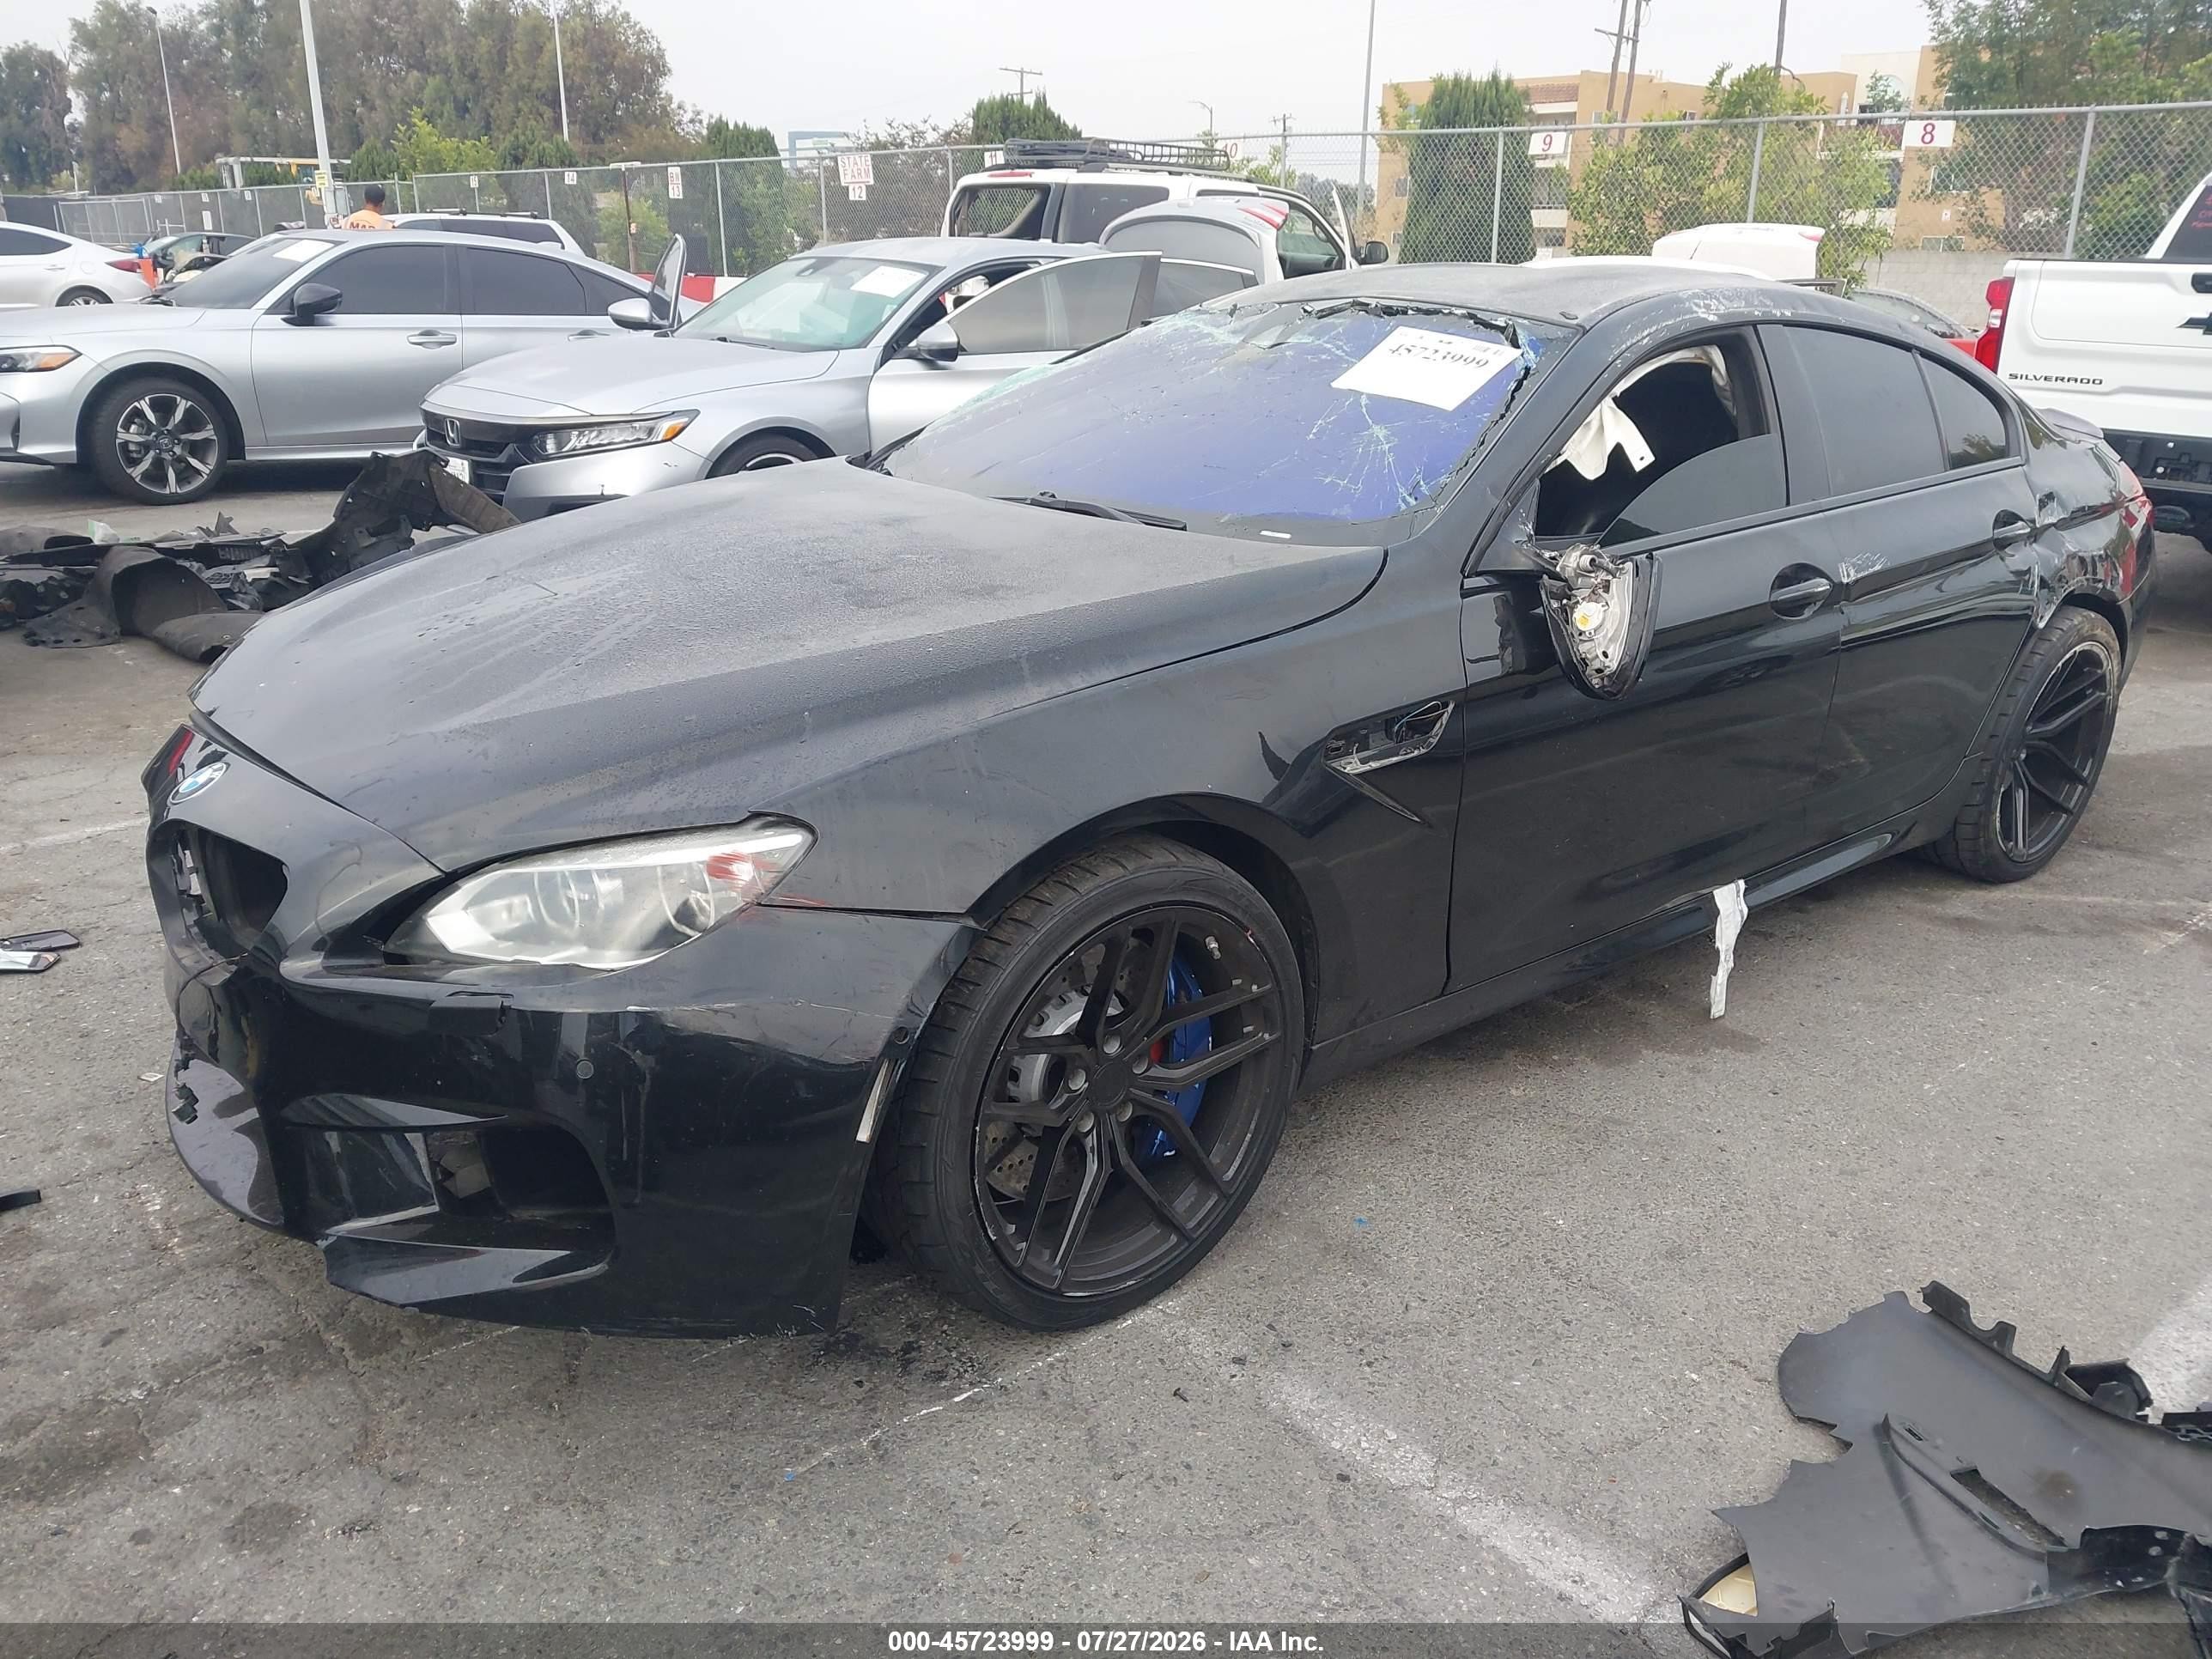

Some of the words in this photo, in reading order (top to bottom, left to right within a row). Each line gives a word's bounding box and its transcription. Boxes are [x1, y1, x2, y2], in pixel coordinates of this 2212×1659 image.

[1921, 122, 1936, 145] 8
[1541, 133, 1553, 152] 9
[840, 155, 871, 168] STATE
[988, 150, 998, 166] 11
[567, 172, 575, 183] 14
[842, 167, 871, 180] FARM
[671, 185, 681, 198] 13
[852, 185, 864, 199] 12
[2008, 373, 2103, 386] SILVERADO
